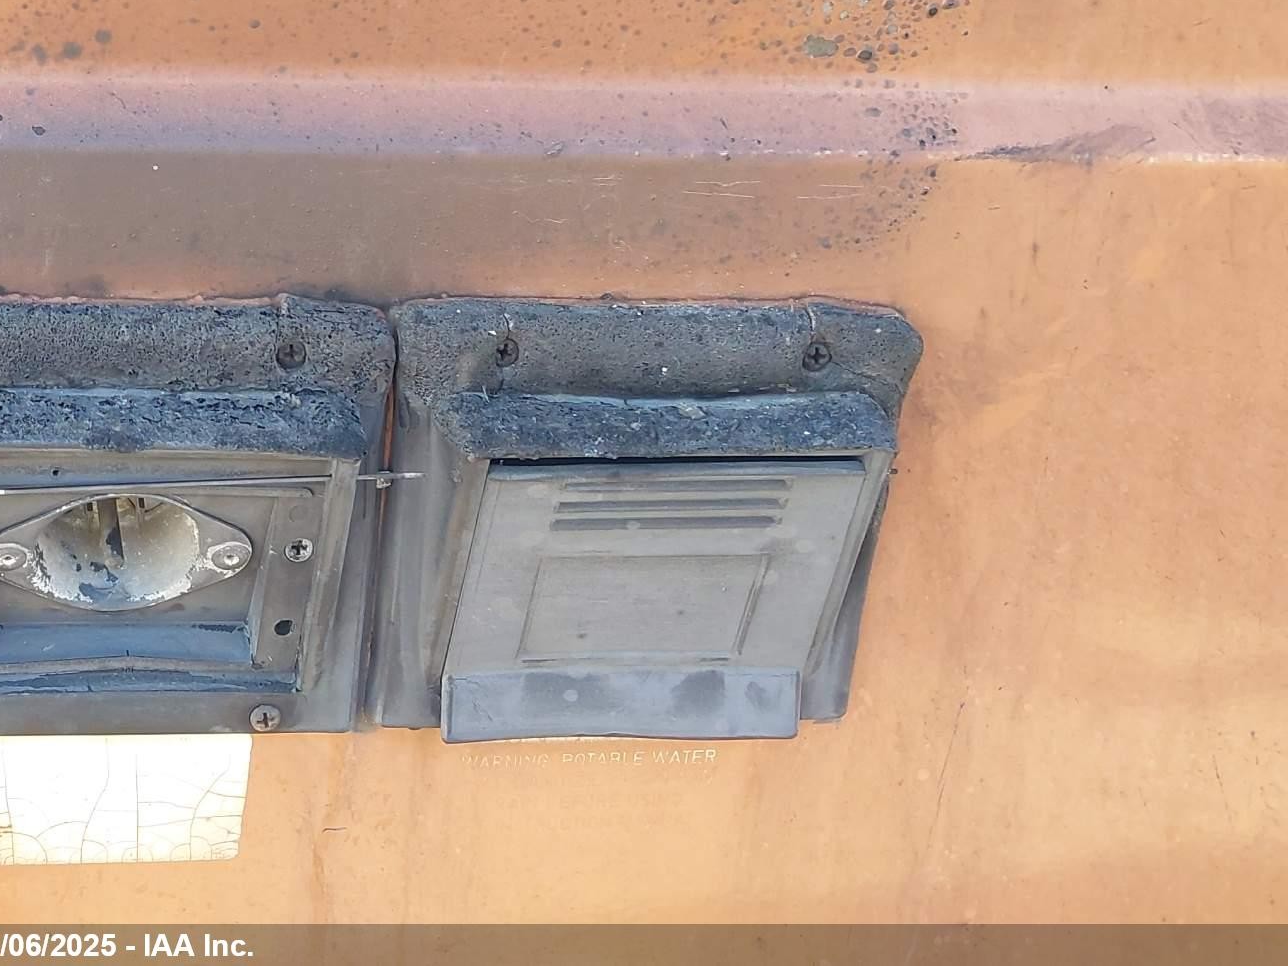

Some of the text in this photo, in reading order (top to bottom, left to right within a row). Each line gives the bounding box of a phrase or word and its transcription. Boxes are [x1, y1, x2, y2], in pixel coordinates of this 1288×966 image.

[460, 749, 717, 769] WARNING POTABLE WATER
